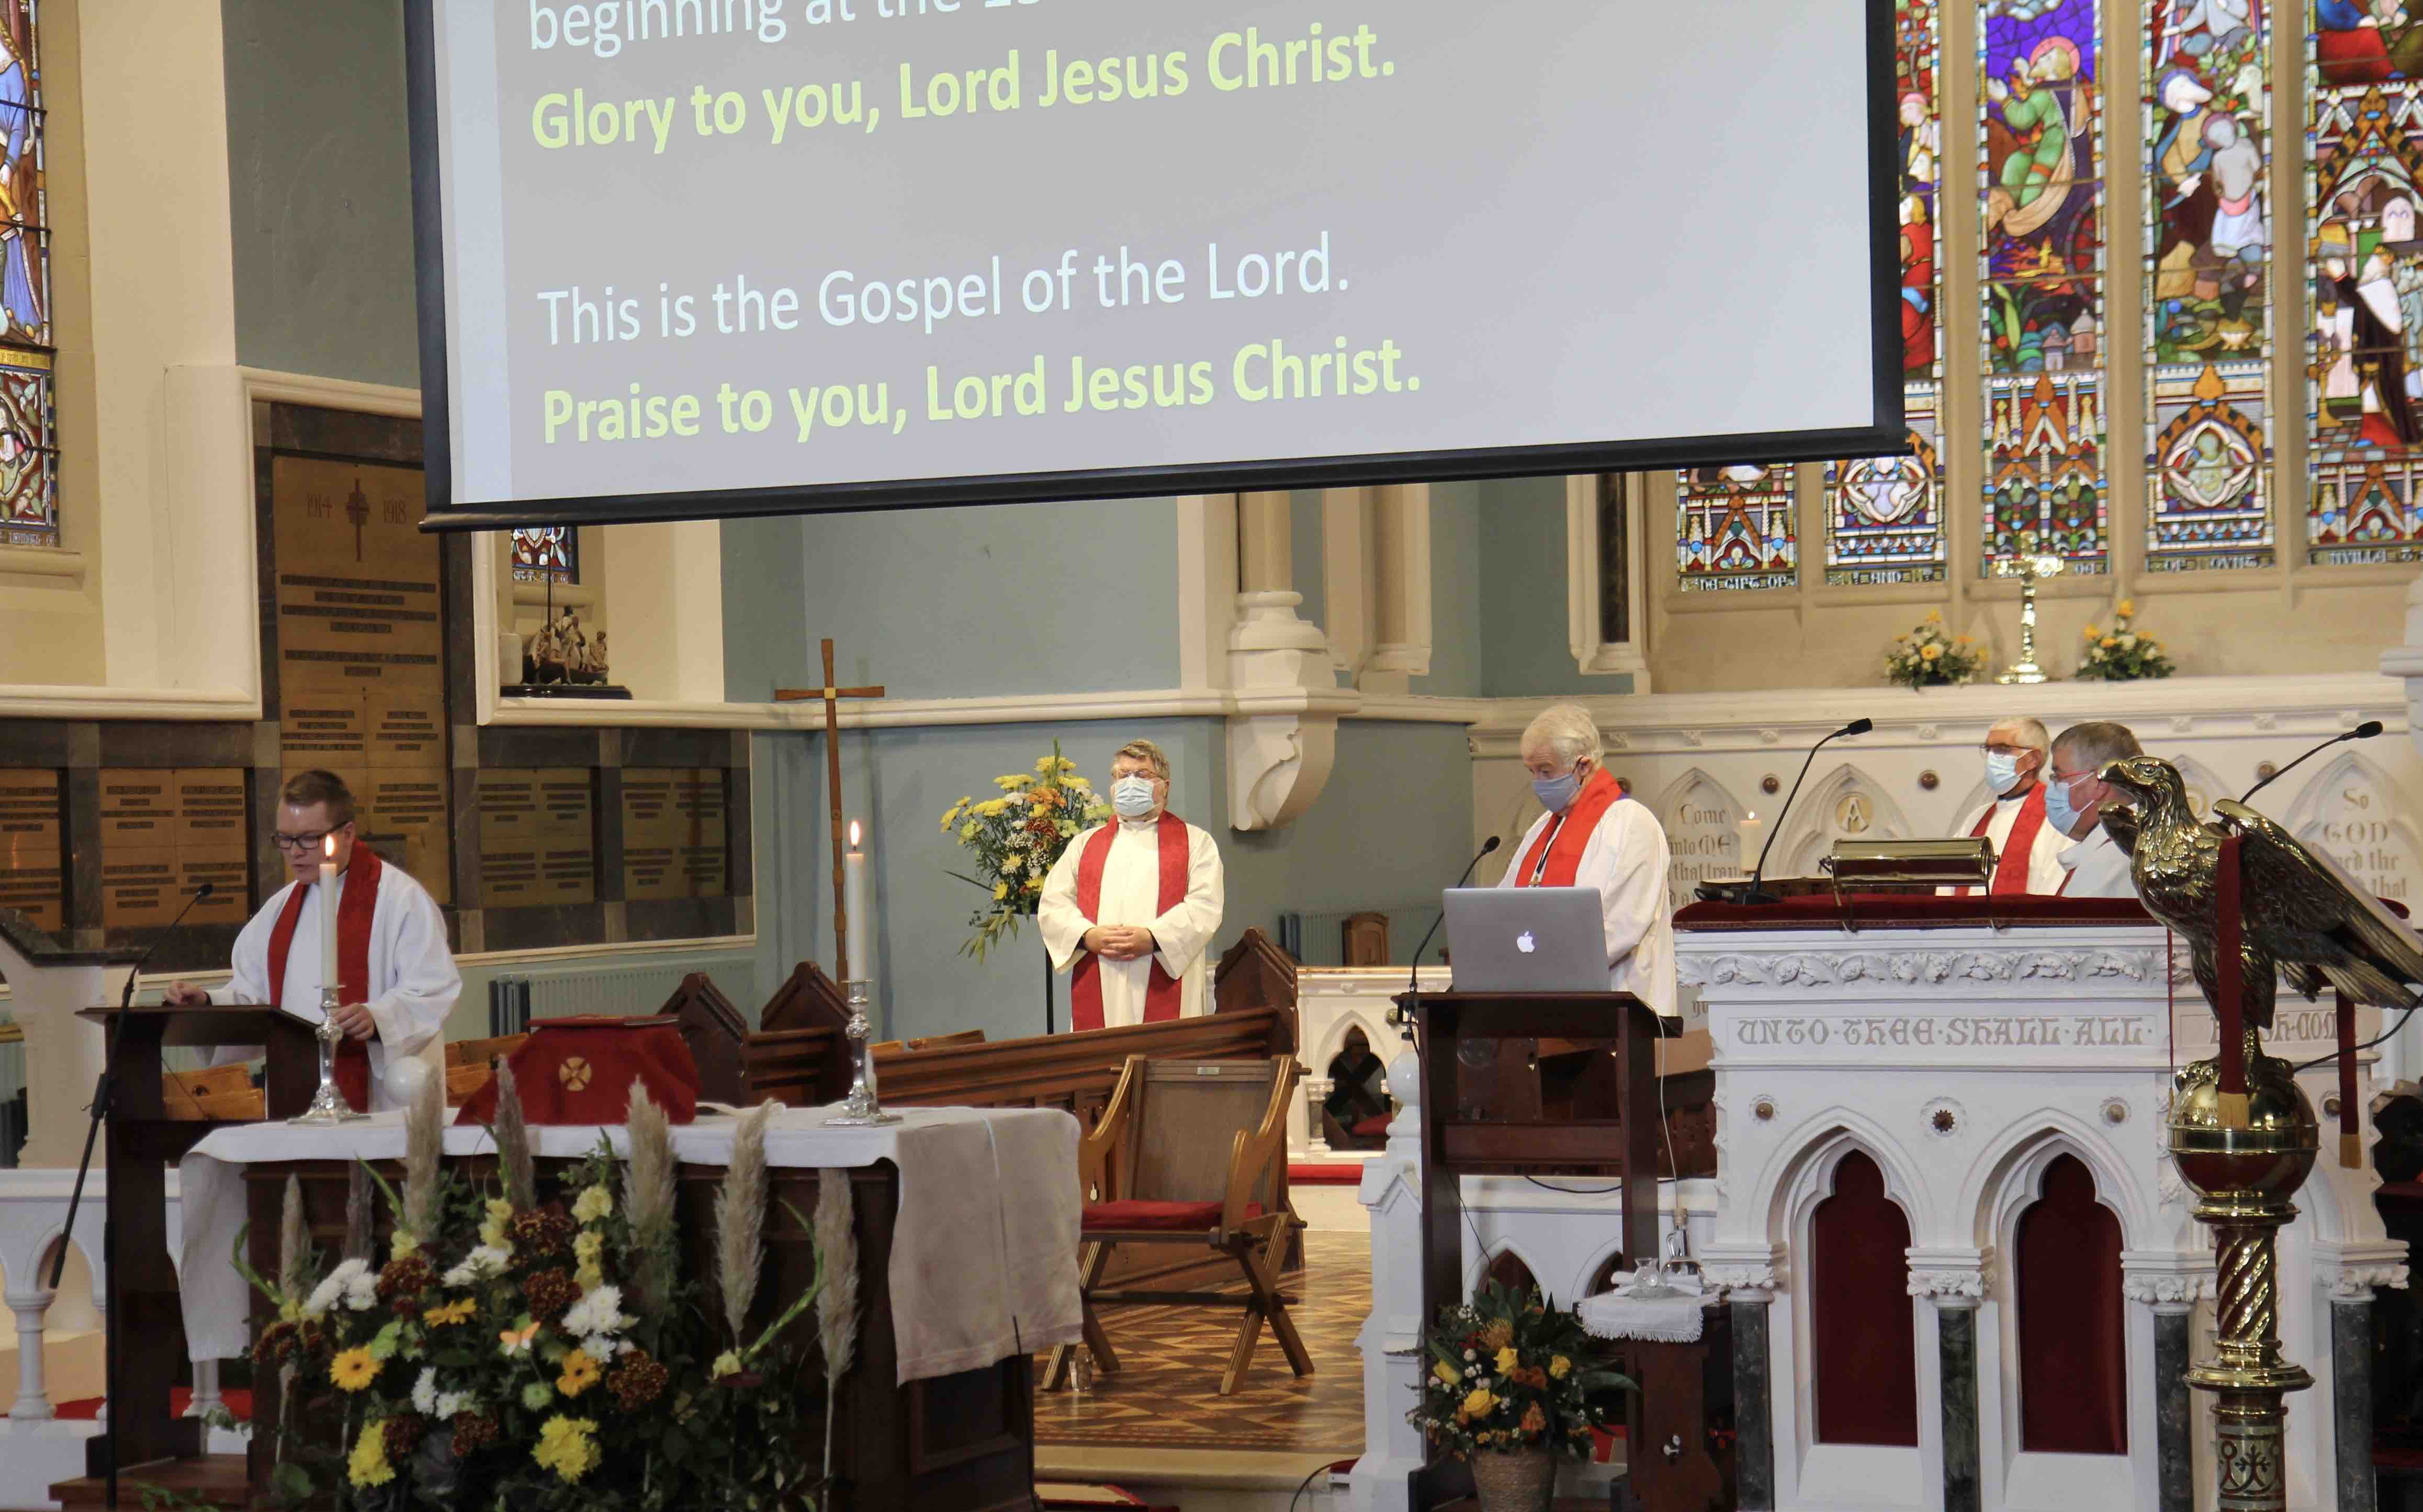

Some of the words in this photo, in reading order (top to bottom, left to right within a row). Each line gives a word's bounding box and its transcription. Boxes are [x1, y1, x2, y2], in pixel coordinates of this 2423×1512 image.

[530, 0, 786, 58] beginning
[532, 88, 674, 153] Glory
[691, 85, 746, 136] to
[762, 81, 880, 143] you,
[899, 49, 1021, 118] Lord
[1039, 49, 1189, 107] Jesus
[1207, 22, 1394, 91] Christ.
[537, 287, 640, 345] This
[660, 283, 696, 337] is
[712, 275, 799, 334] the
[819, 256, 1000, 334] Gospel
[1022, 249, 1078, 313] of
[1093, 245, 1186, 308] the
[1209, 230, 1349, 300] Lord.
[545, 383, 700, 443] Praise
[717, 382, 772, 433] to
[789, 381, 907, 443] you,
[927, 355, 1045, 420] Lord
[1064, 355, 1213, 413] Jesus
[1233, 336, 1419, 401] Christ.
[307, 493, 332, 519] 1914
[382, 498, 407, 524] 1918
[2343, 787, 2369, 810] So
[1682, 804, 1726, 825] Come
[2323, 821, 2388, 845] GOD
[1737, 1019, 1829, 1046] UNTO
[1946, 1018, 2060, 1046] SHALL
[2073, 1017, 2143, 1046] ALL
